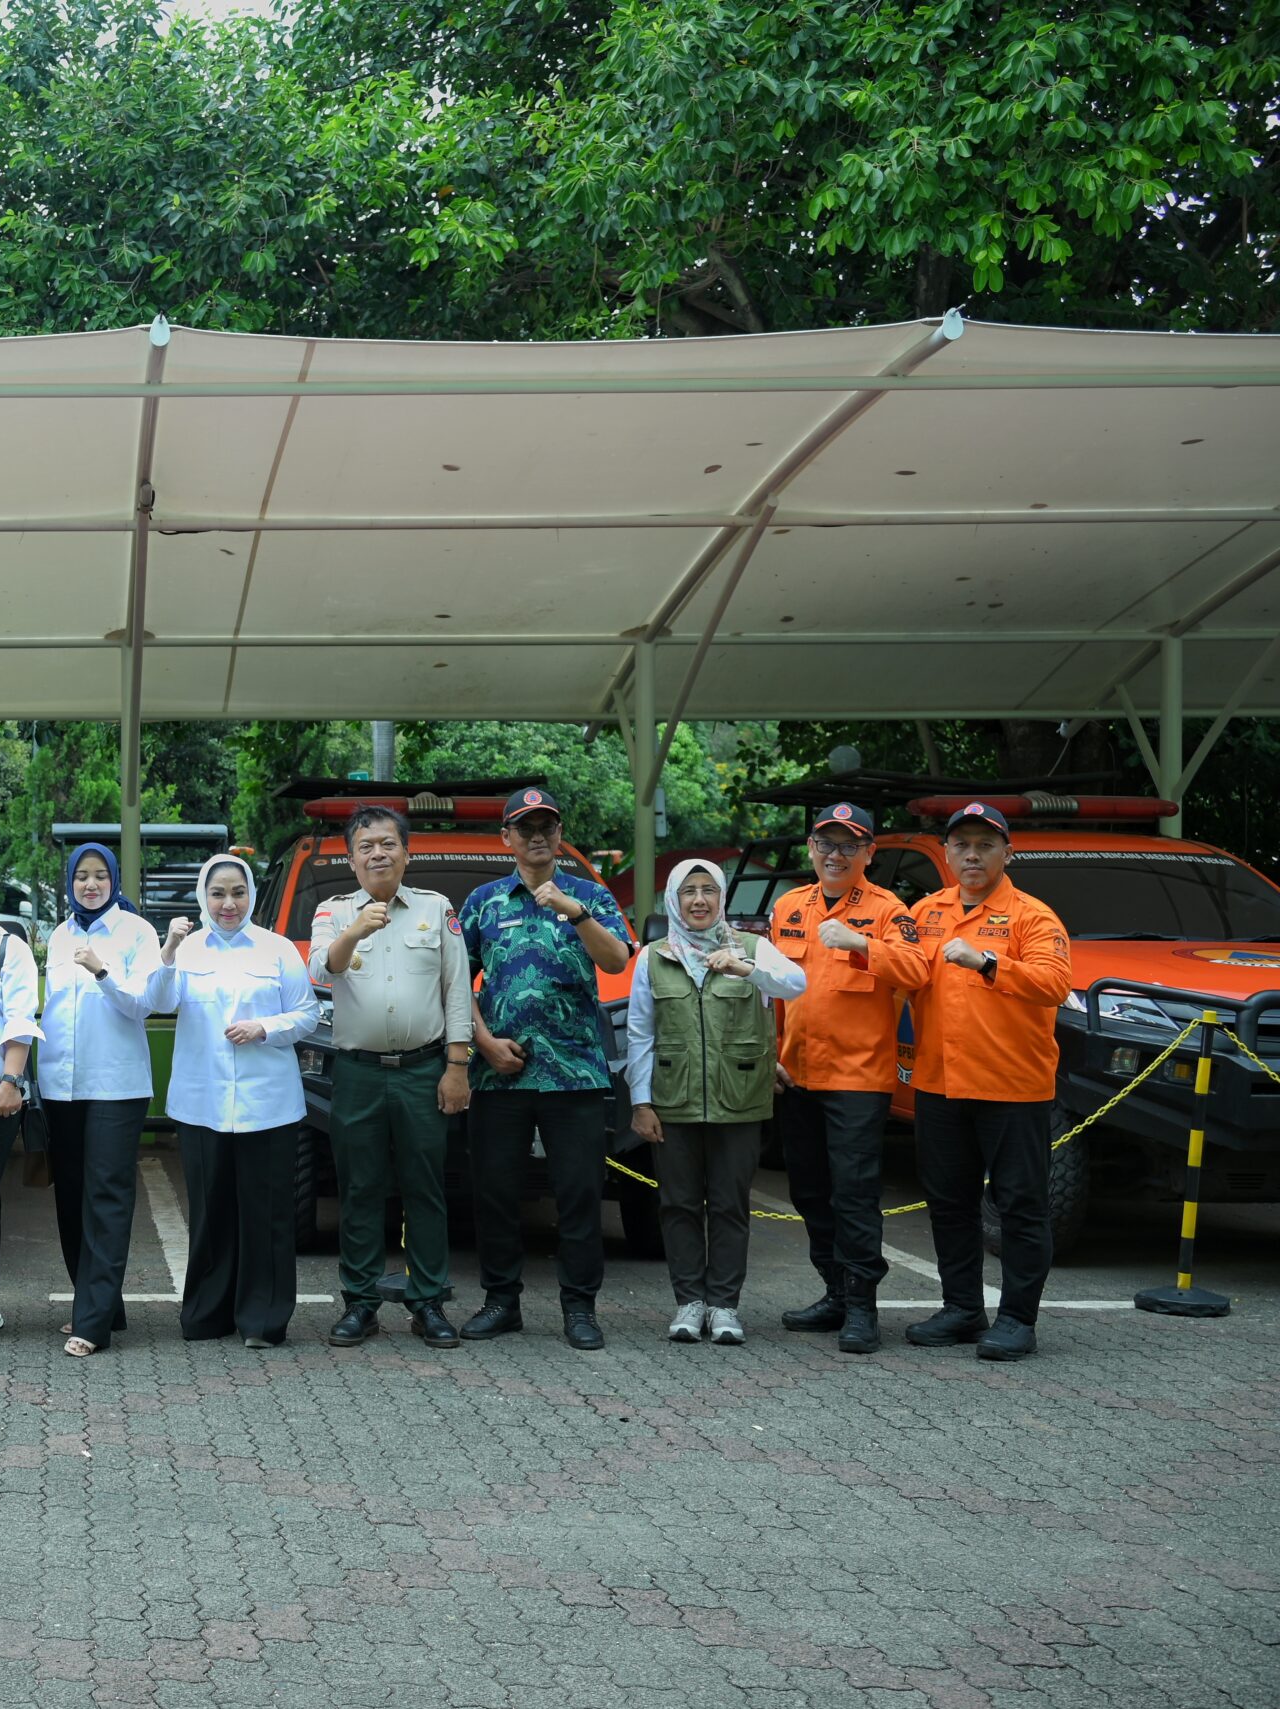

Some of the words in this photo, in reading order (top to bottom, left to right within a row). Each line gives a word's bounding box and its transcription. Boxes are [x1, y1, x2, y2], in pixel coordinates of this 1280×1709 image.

[1100, 852, 1143, 860] BENCANA
[1141, 853, 1180, 861] DAERAH
[1177, 855, 1204, 863] KOTA
[979, 928, 1009, 937] BPBD
